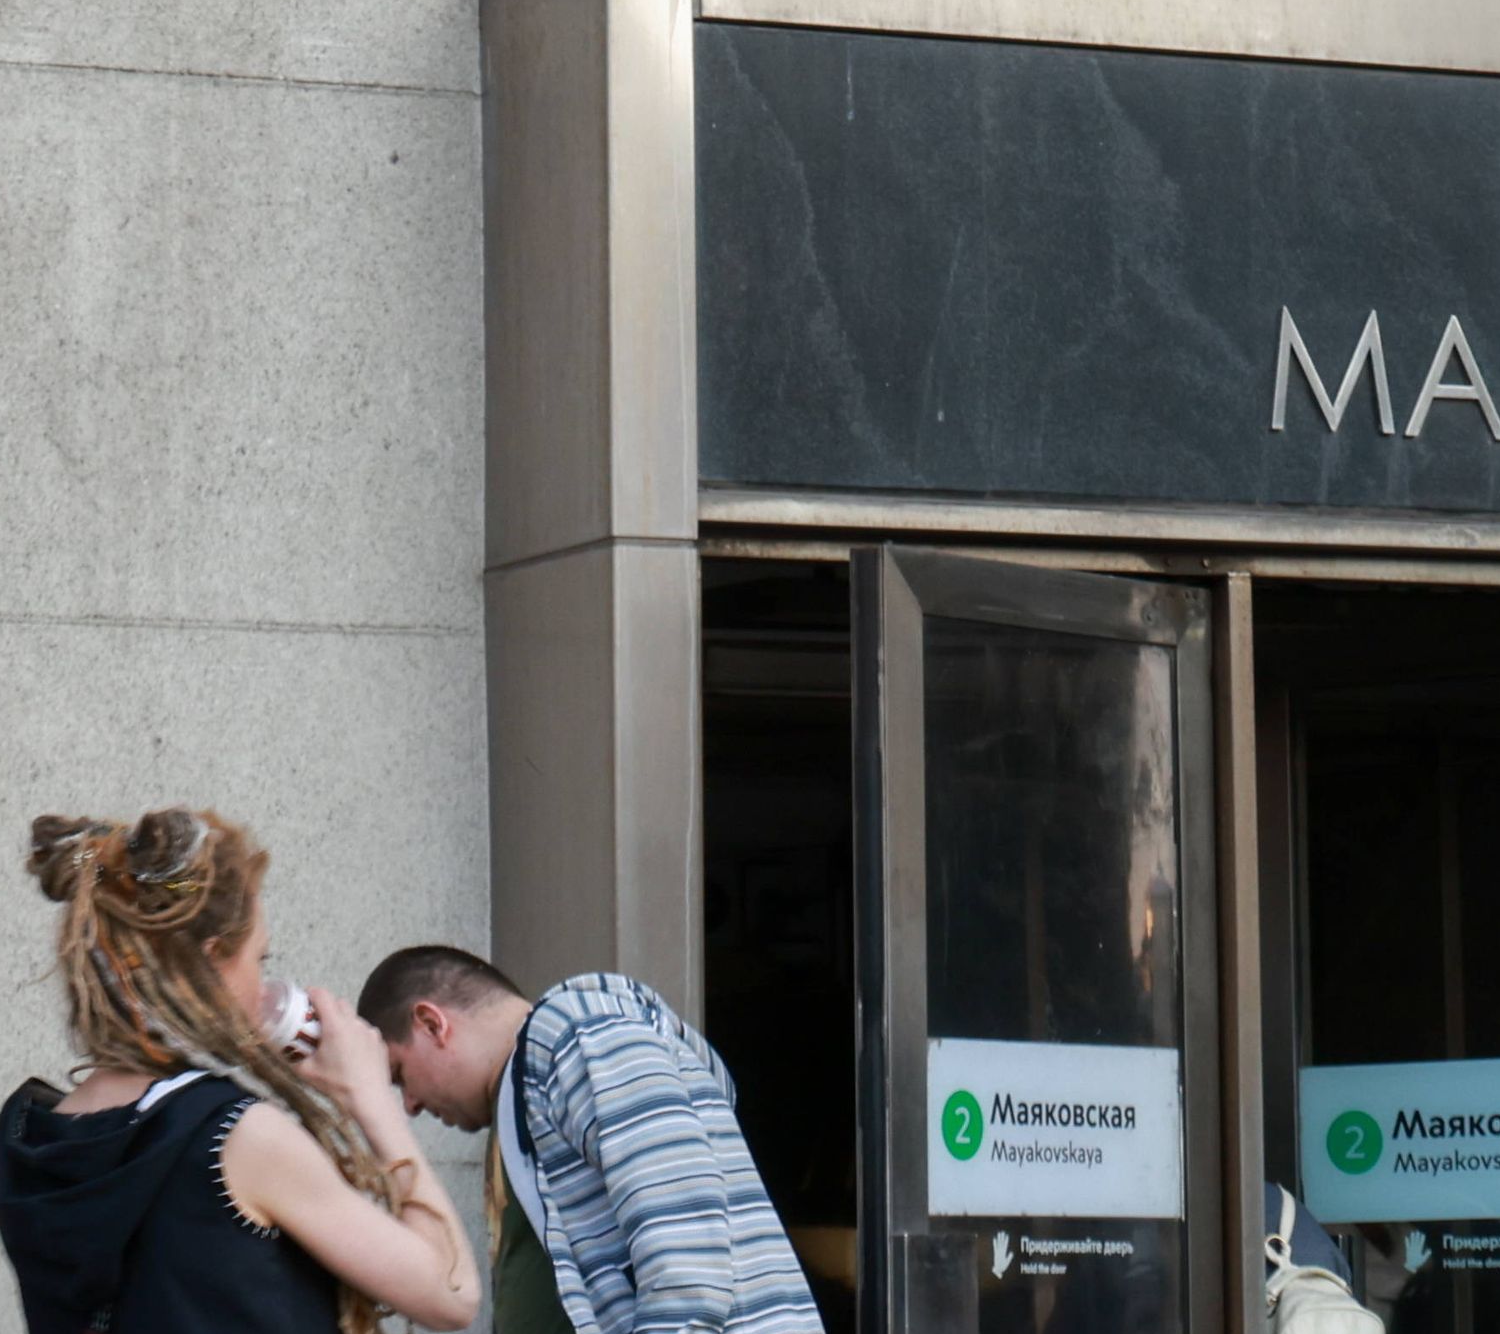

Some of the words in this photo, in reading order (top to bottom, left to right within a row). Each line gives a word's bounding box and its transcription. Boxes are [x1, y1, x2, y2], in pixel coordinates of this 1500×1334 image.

[954, 1106, 972, 1145] 2
[989, 1092, 1137, 1130] Маяковская
[989, 1138, 1104, 1169] Mayakovskaya
[1343, 1124, 1367, 1161] 2
